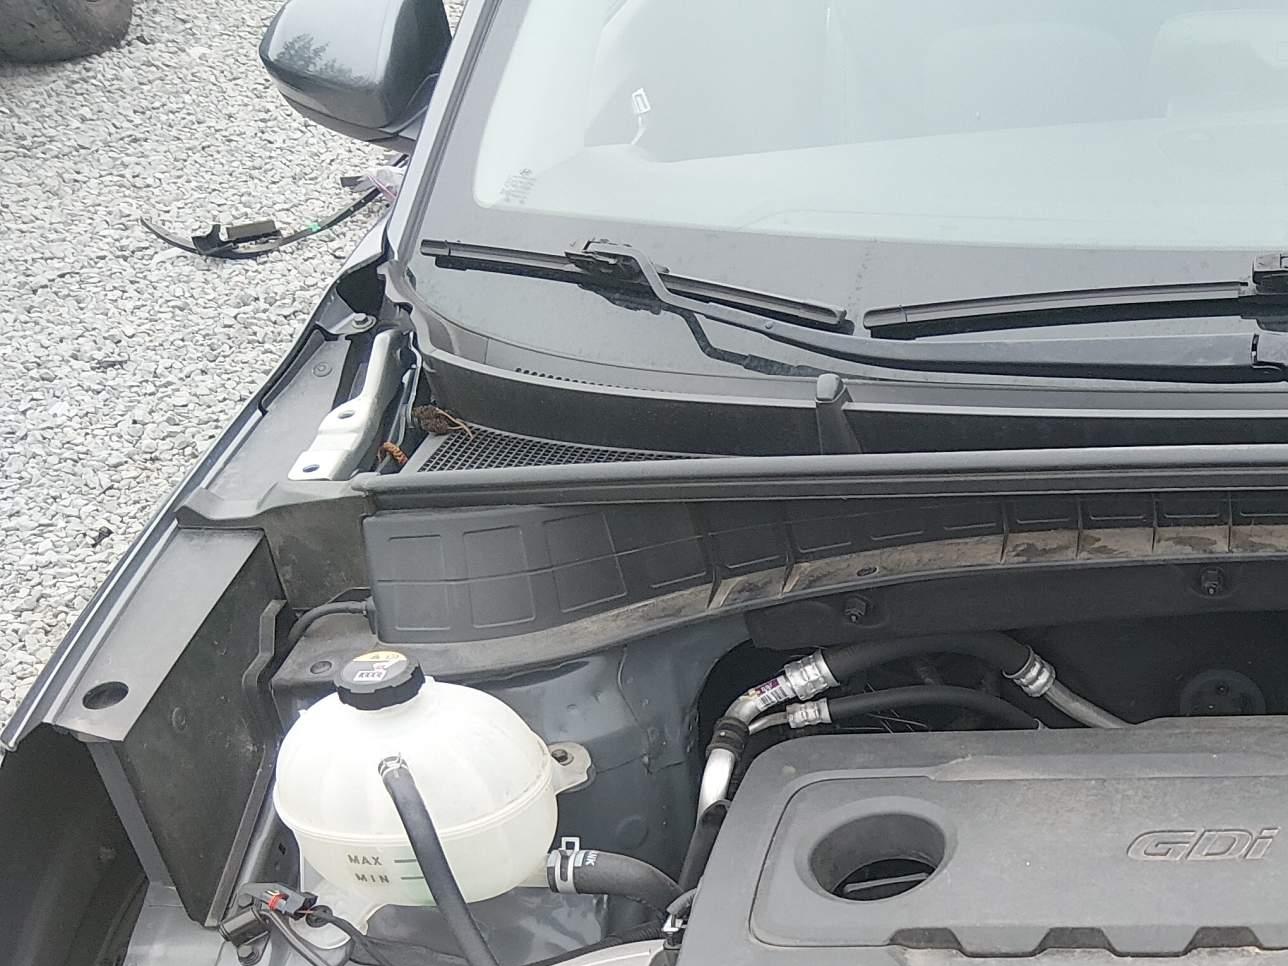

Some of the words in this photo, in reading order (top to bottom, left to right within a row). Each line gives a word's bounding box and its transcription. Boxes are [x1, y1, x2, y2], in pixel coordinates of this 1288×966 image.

[1127, 827, 1281, 861] GDi
[347, 854, 382, 866] MAX
[355, 872, 390, 884] MIN
